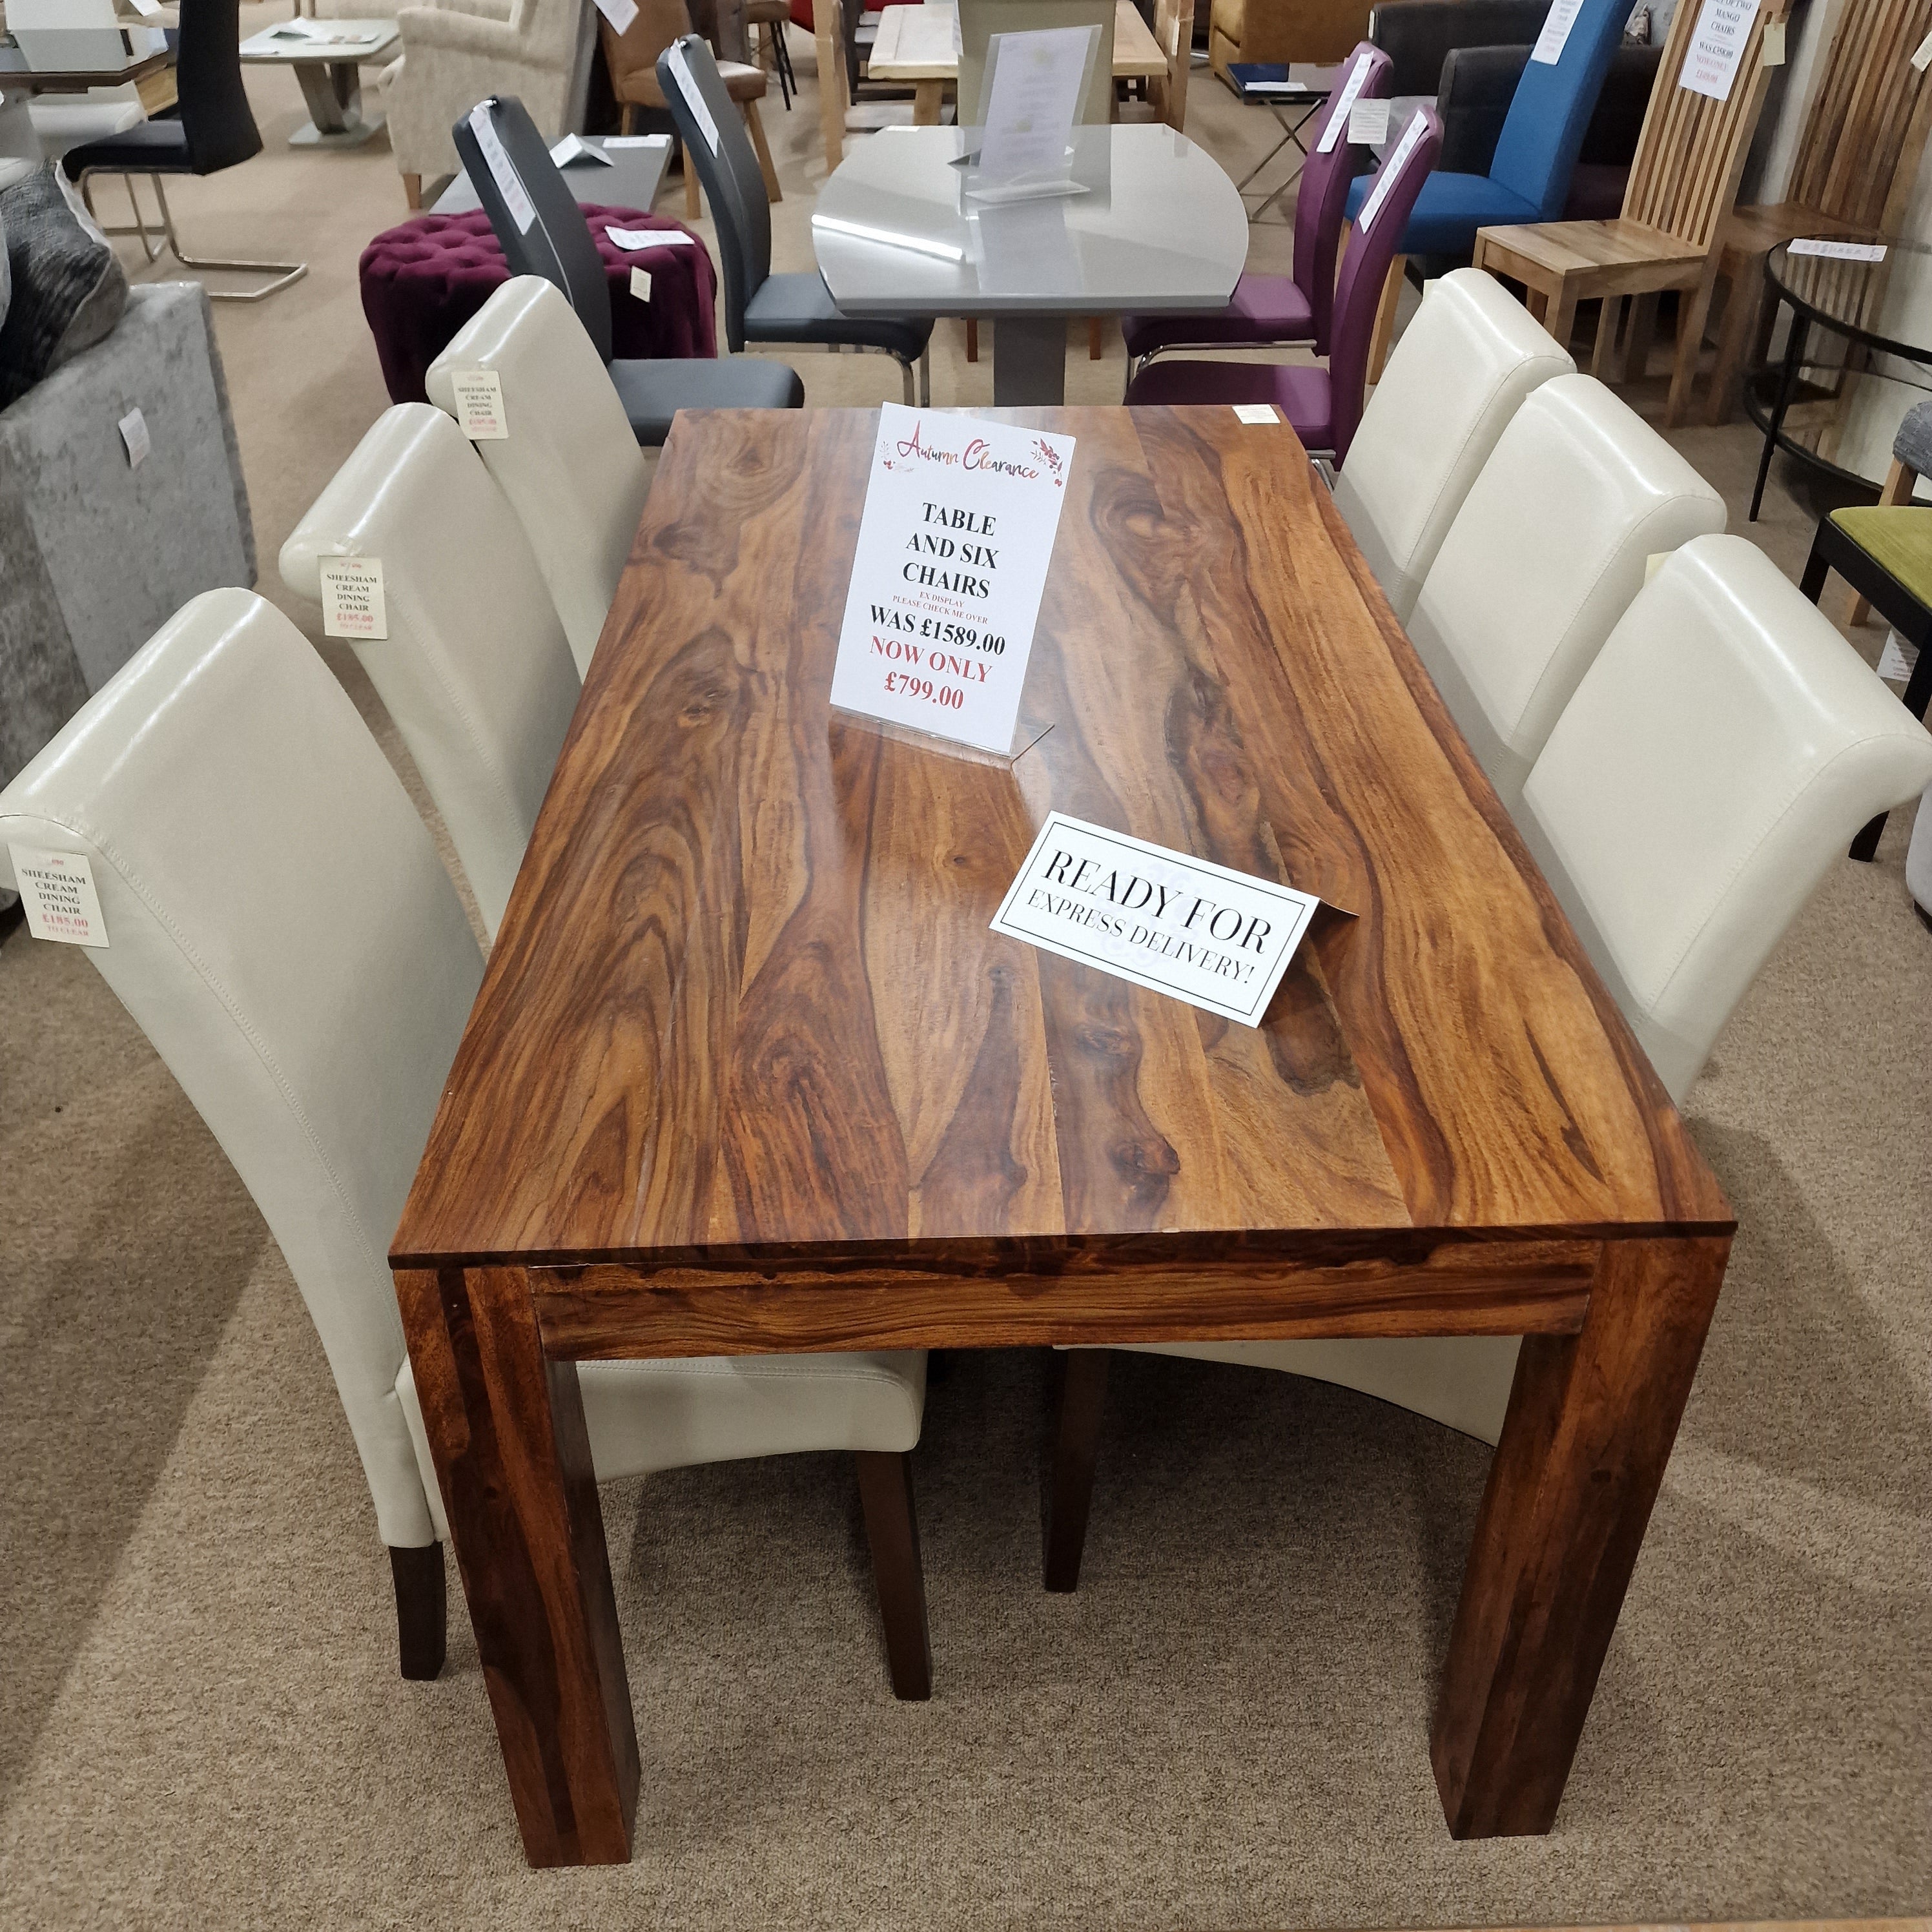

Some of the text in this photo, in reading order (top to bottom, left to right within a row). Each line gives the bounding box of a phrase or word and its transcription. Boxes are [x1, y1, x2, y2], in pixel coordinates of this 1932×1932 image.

[1715, 8, 1740, 22] MANGO
[1711, 21, 1736, 36] CHAIRS
[897, 420, 1040, 479] Autumn Clearance
[922, 502, 997, 537] TABLE
[905, 533, 1000, 570] AND SIX
[327, 574, 377, 584] SHEESHAM
[903, 562, 991, 599] CHAIRS
[337, 593, 370, 602] DINING
[920, 591, 965, 608] EX DISPLAY
[339, 603, 369, 611] CHAIR
[893, 595, 988, 625] PLEASE CHECK ME OVER
[870, 604, 1007, 656] WAS £1589.00
[869, 635, 995, 684] NOW ONLY
[883, 671, 964, 710] £799.00
[21, 868, 86, 885] SHEESHAM
[35, 881, 78, 894] CREAM
[39, 892, 81, 905] DINING
[1040, 848, 1273, 954] READY FOR
[43, 903, 81, 915] CHAIR
[43, 914, 88, 927] £185.00
[1027, 889, 1256, 985] EXPRESS DELIVERY!
